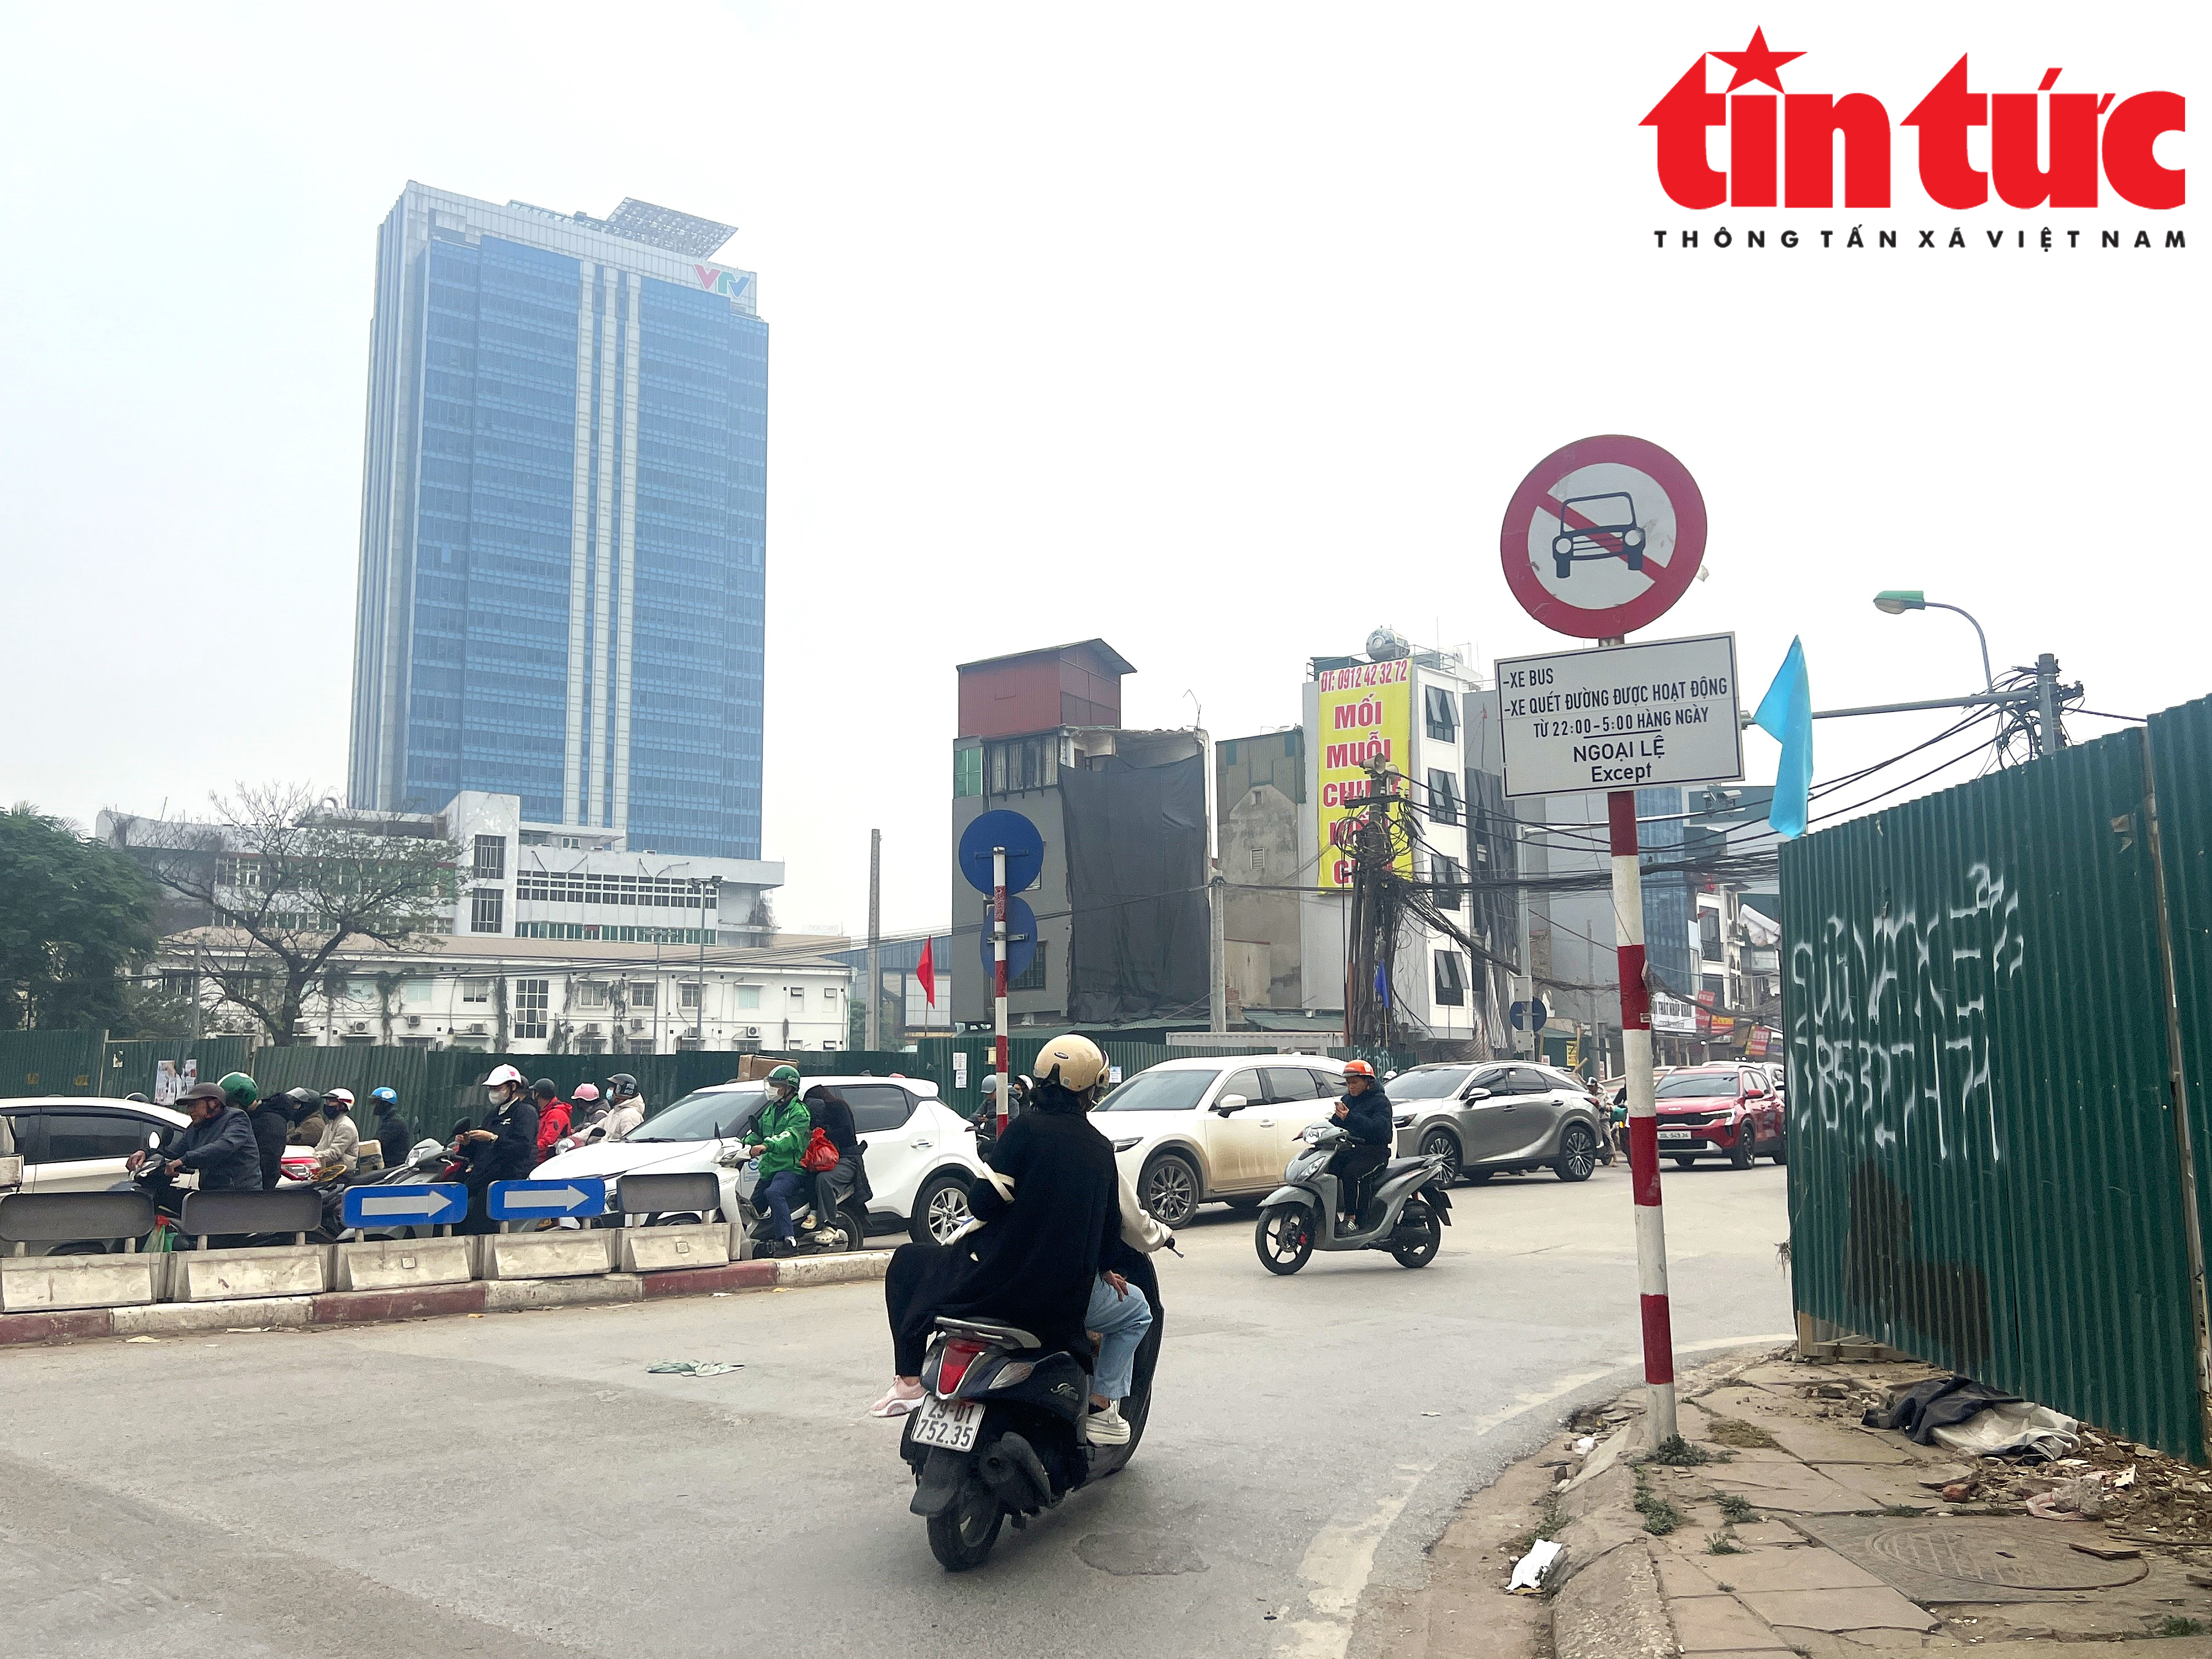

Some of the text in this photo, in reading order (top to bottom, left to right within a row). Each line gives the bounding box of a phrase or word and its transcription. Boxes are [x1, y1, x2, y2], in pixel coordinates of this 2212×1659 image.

[693, 264, 750, 297] VTV
[1321, 660, 1408, 693] ĐT: 0912 42 32 72
[1503, 668, 1554, 689] -XE BUS
[1334, 693, 1382, 730] MỐI
[1504, 676, 1728, 716] -XE QUÉT ĐƯỜNG ĐƯỢC HOẠT ĐỘNG
[1534, 719, 1551, 738] TỪ
[1638, 709, 1671, 729] HÀNG
[1676, 704, 1709, 725] NGÀY
[1573, 736, 1665, 763] NGOẠI LỆ
[1592, 762, 1652, 783] Except
[916, 1419, 973, 1447] 752.35
